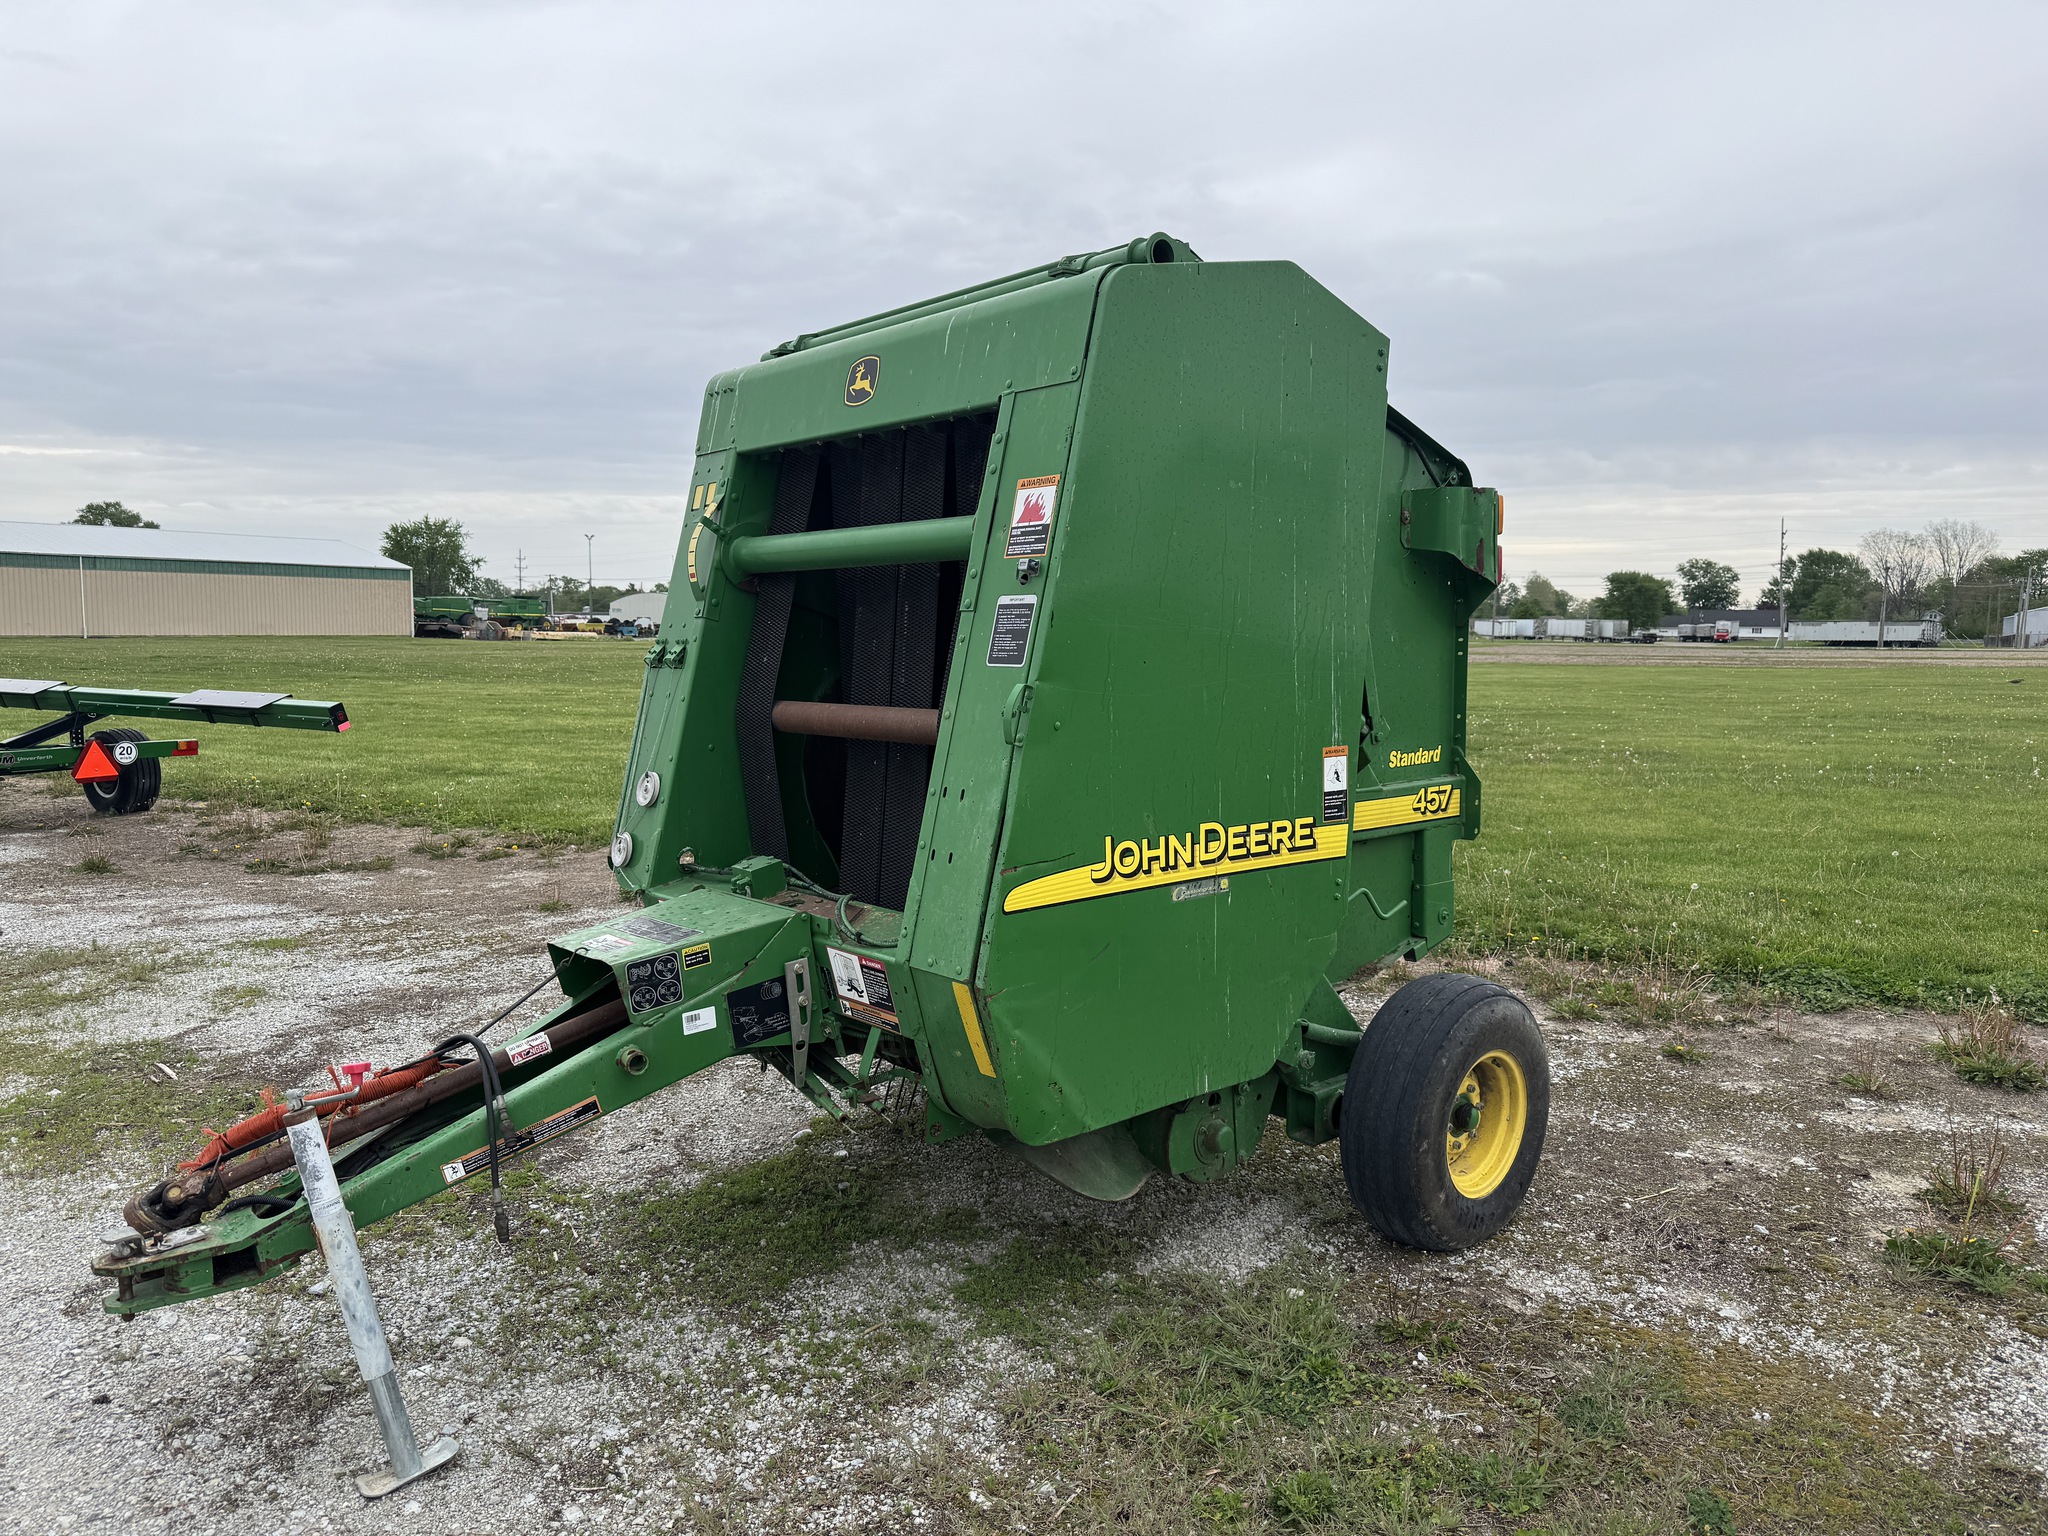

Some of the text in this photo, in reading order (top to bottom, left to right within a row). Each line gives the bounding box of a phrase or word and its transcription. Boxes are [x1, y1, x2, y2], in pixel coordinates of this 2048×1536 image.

[1026, 476, 1056, 486] WARNING
[118, 745, 133, 756] 20
[1388, 745, 1442, 769] Standard
[1411, 784, 1452, 816] 457
[1091, 815, 1318, 883] JOHN DEERE
[687, 945, 708, 953] CAUTION
